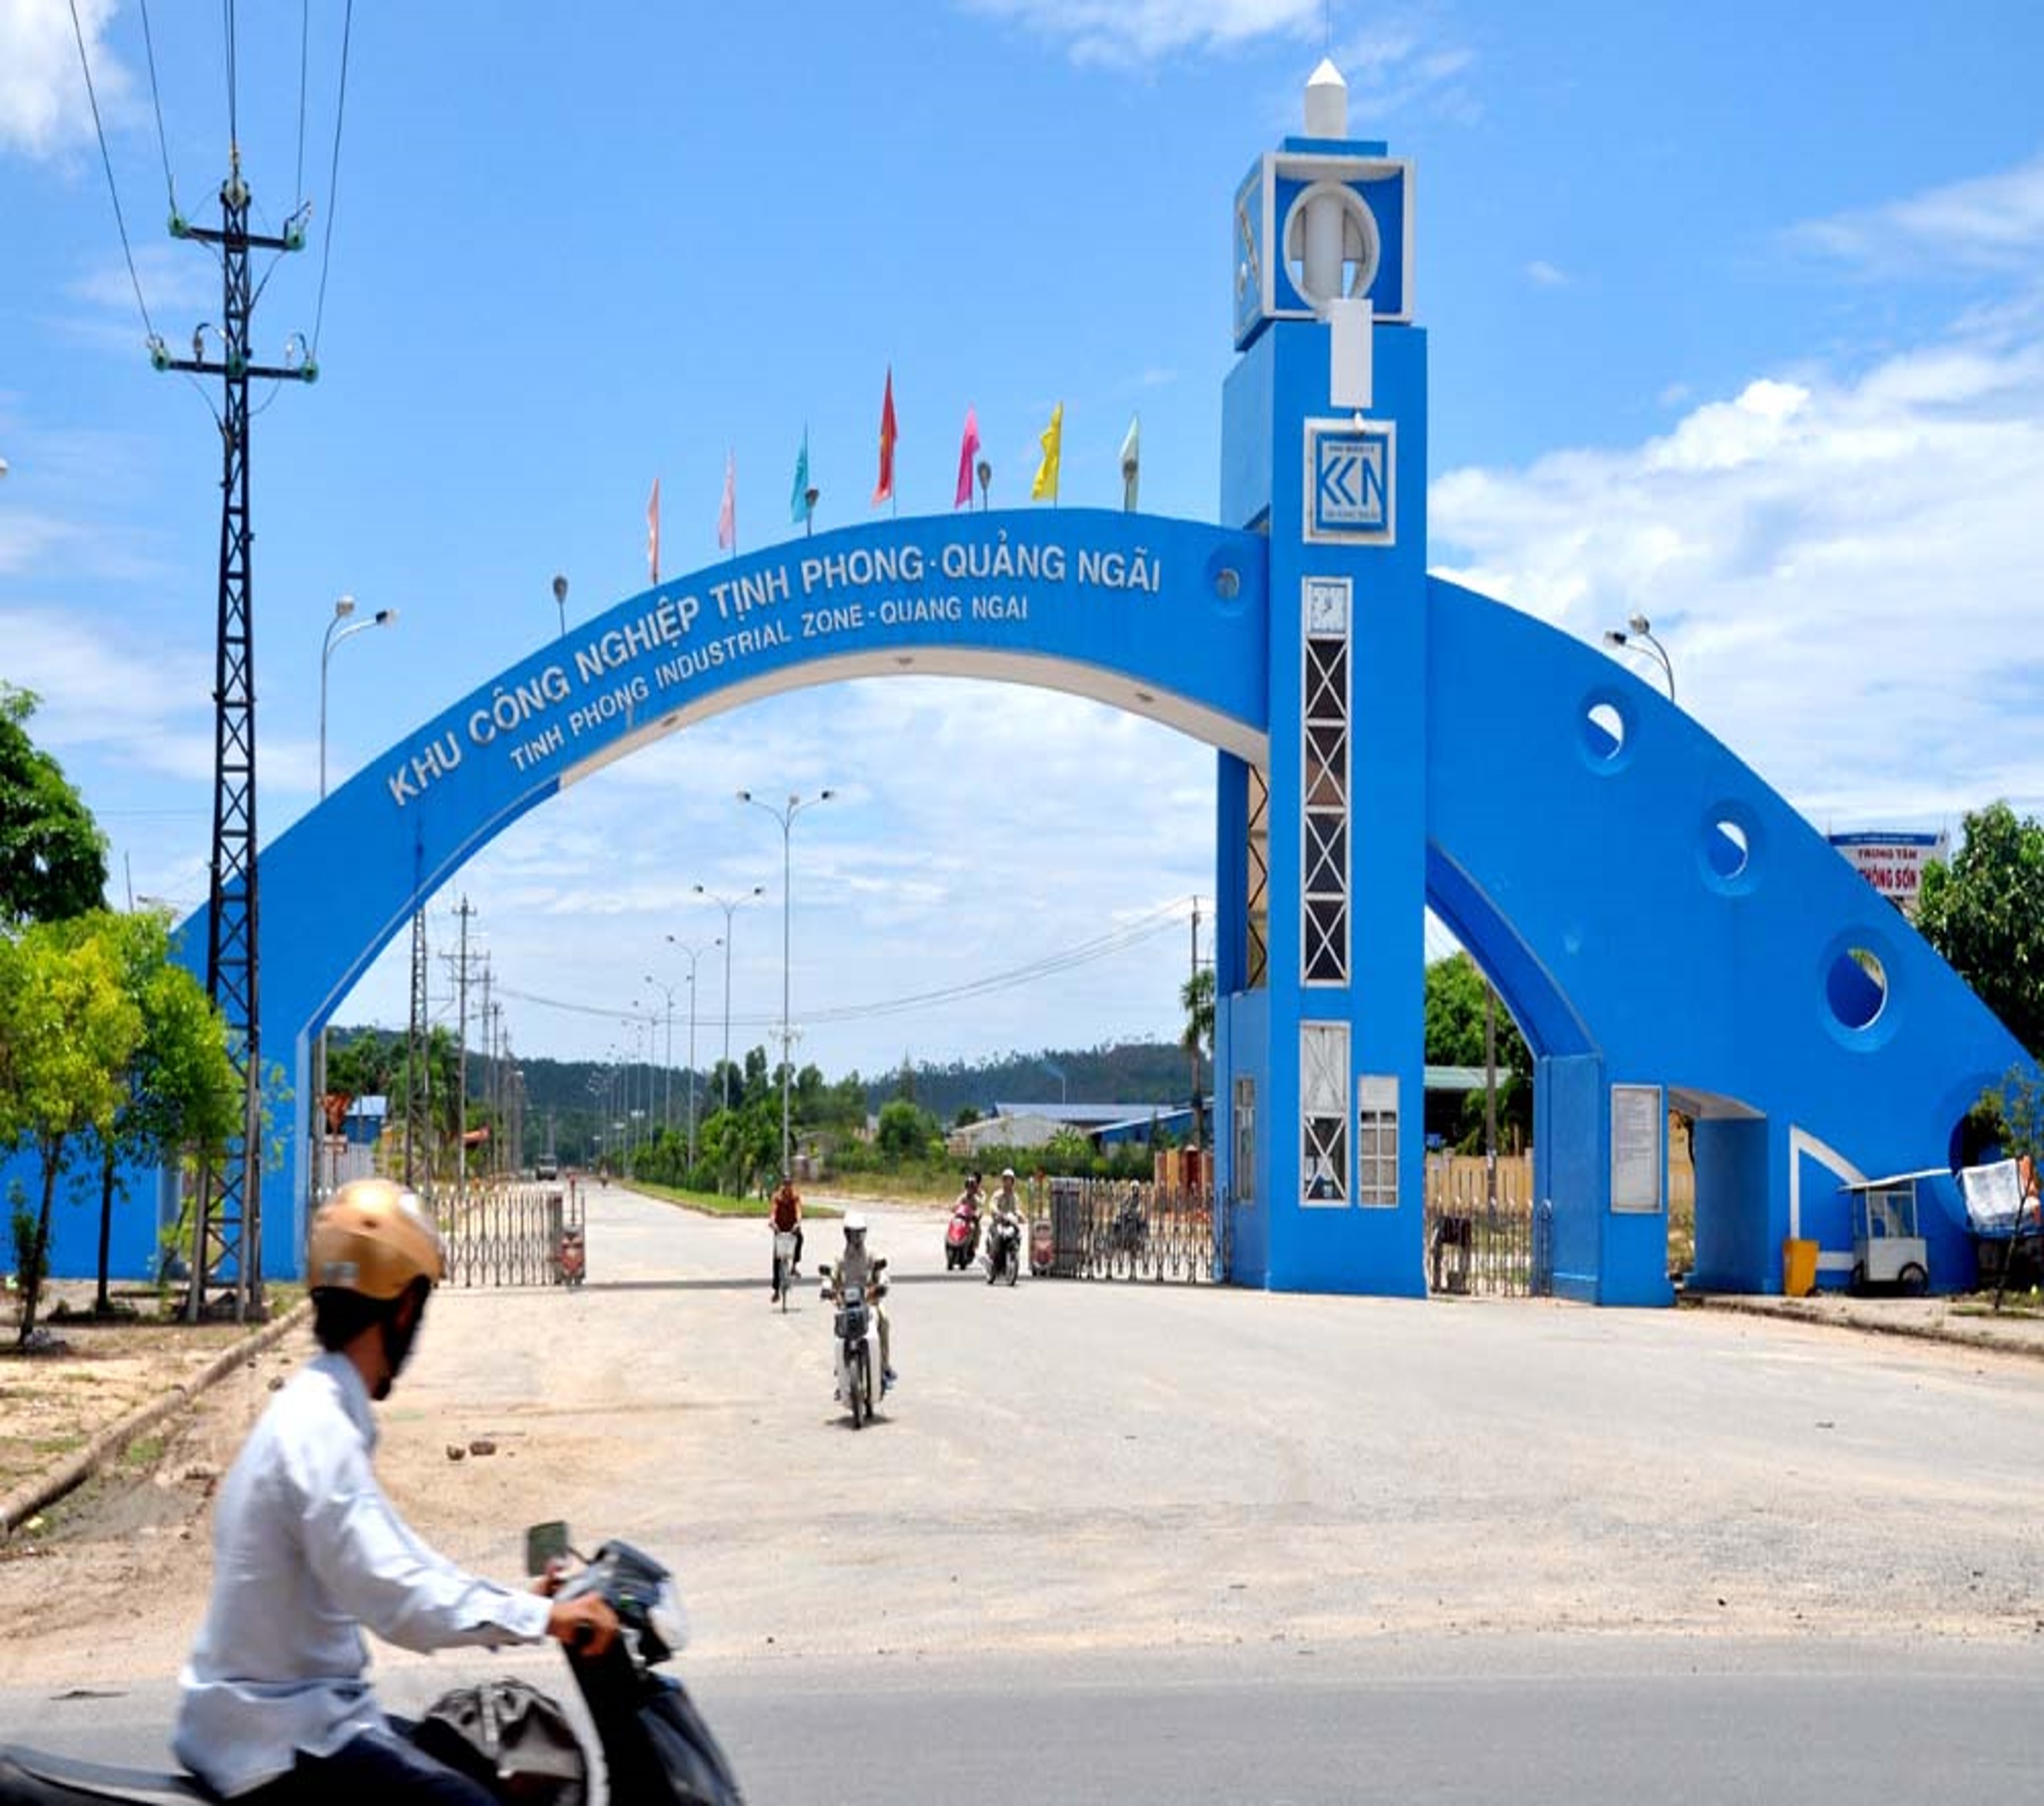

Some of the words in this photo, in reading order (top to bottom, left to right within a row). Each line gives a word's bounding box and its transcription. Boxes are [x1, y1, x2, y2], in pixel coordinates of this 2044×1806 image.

[389, 732, 461, 806] KHU
[469, 666, 571, 743] CÔNG
[575, 596, 699, 683] NGHIỆP
[709, 566, 789, 622] TỊNH
[802, 544, 924, 594] PHONG
[943, 529, 1066, 581] QUẢNG
[1078, 548, 1161, 591] NGÃI
[510, 724, 565, 771] TINH
[568, 676, 649, 736] PHONG
[655, 618, 792, 689] INDUSTRIAL
[802, 604, 864, 638] ZONE
[880, 595, 961, 625] QUANG
[972, 595, 1027, 619] NGAI
